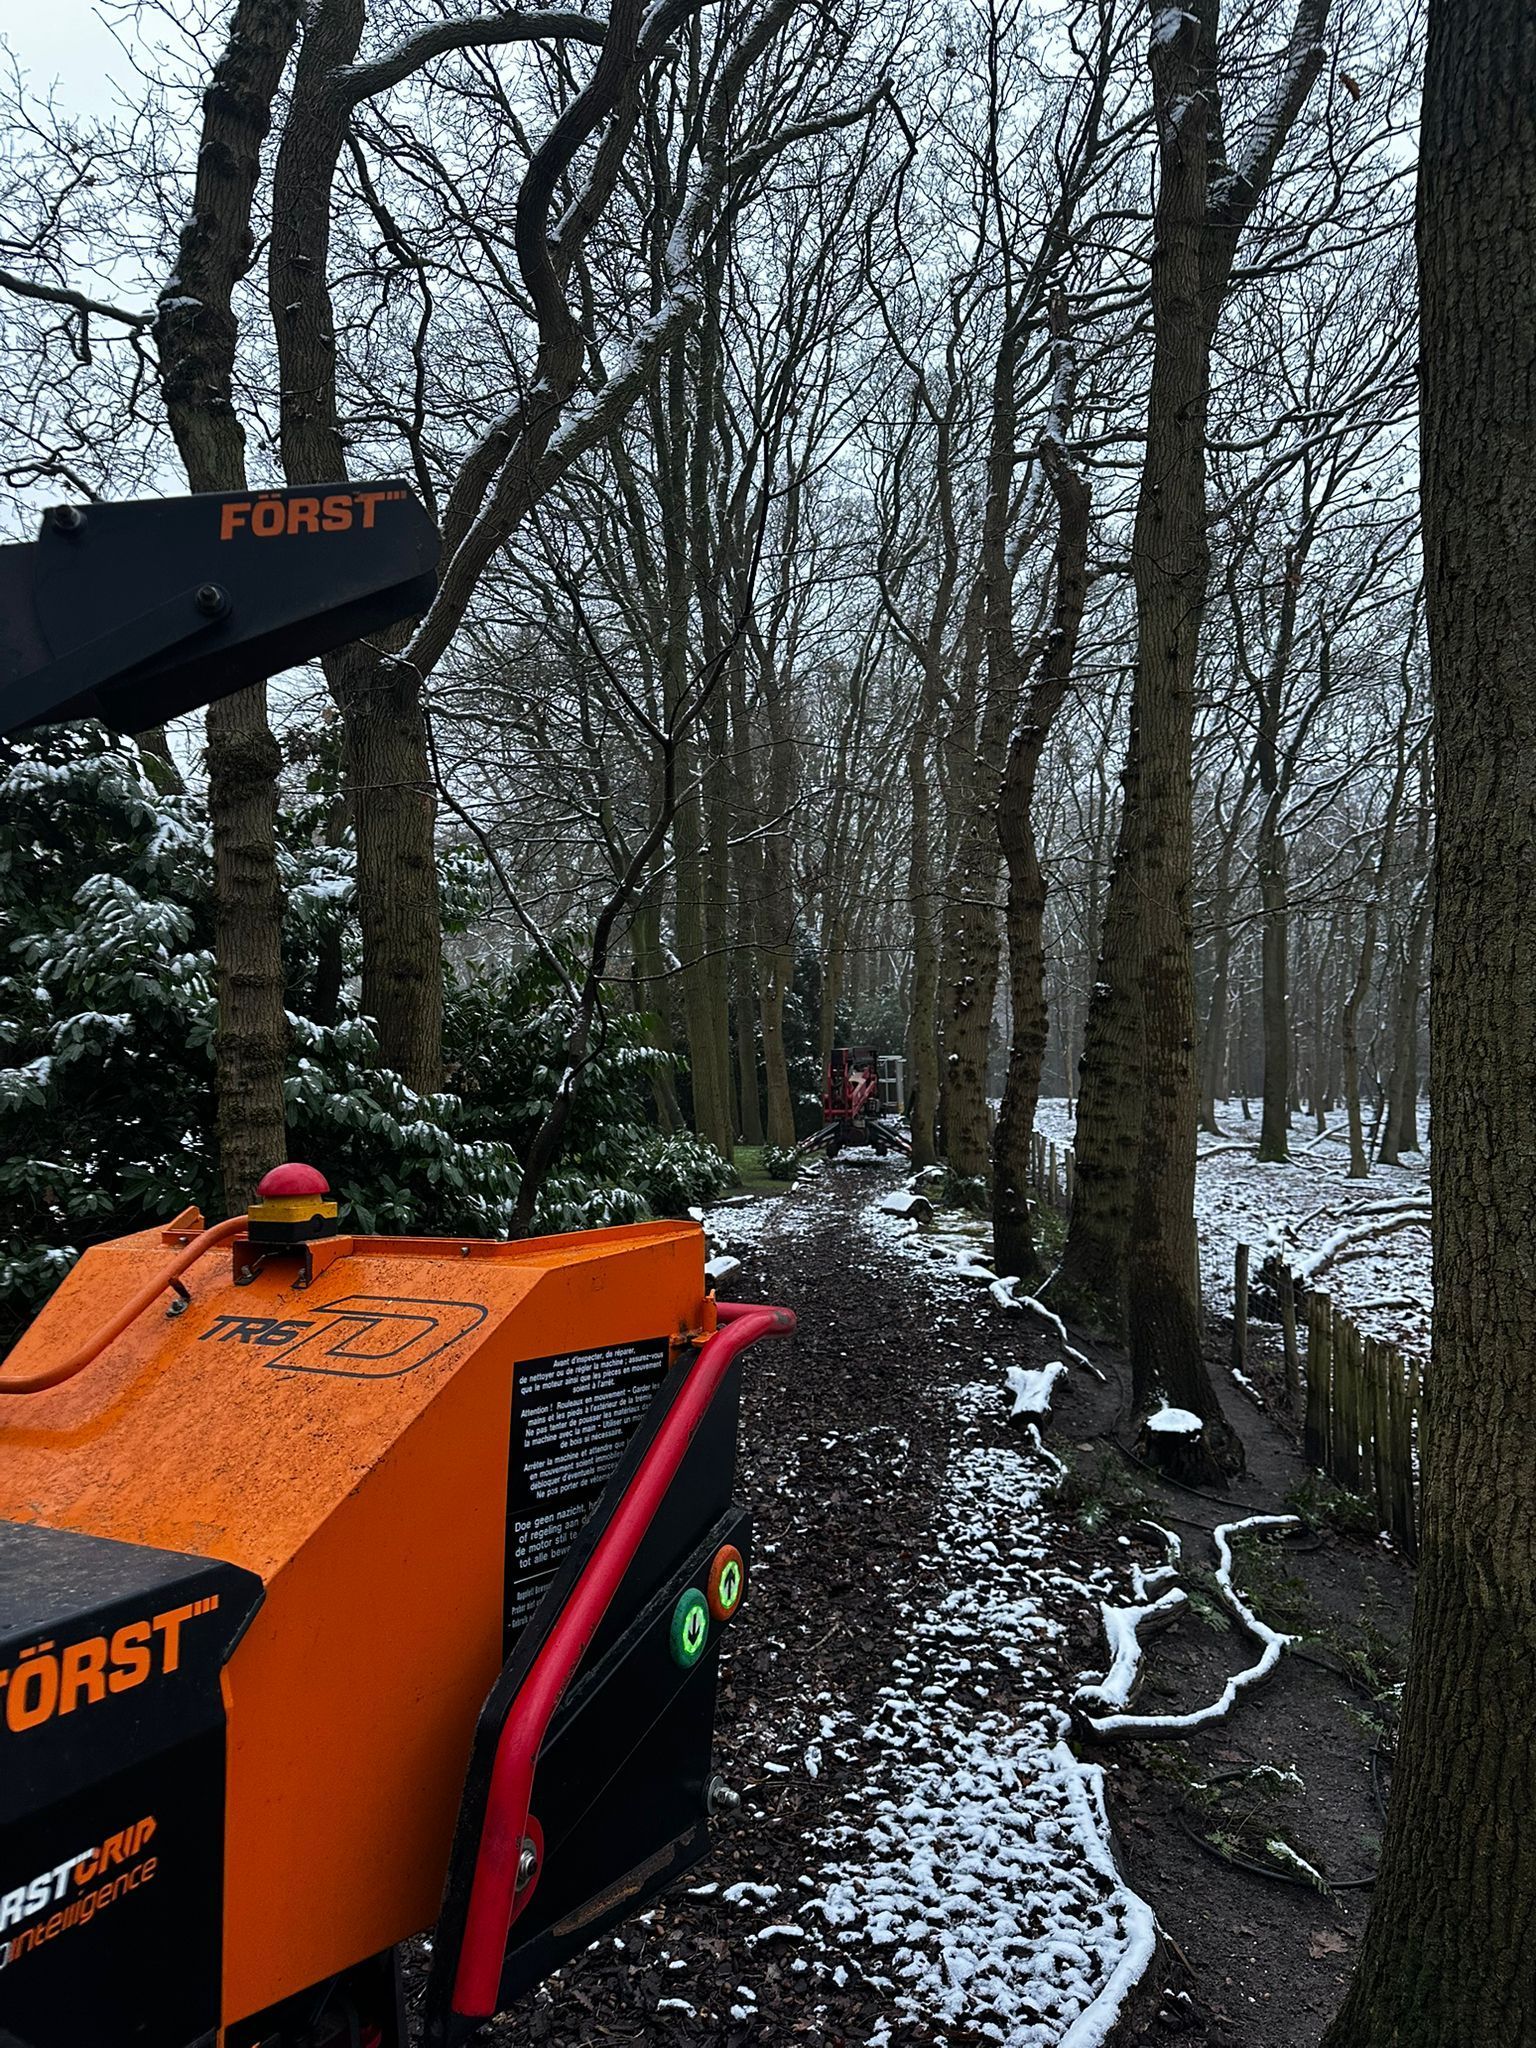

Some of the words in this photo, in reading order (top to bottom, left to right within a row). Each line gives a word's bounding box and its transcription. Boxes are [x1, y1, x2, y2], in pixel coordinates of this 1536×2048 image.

[220, 490, 407, 540] FÖRST
[198, 1315, 316, 1346] TR6
[519, 1376, 527, 1384] de
[529, 1371, 554, 1383] nettoyer
[556, 1369, 564, 1377] ou
[566, 1366, 573, 1375] de
[575, 1362, 592, 1374] régler
[594, 1360, 599, 1369] la
[601, 1358, 623, 1368] machine
[629, 1351, 663, 1363] assurez-vous
[553, 1357, 569, 1368] Avant
[571, 1352, 604, 1364] d'inspecter,
[606, 1350, 613, 1358] de
[521, 1386, 532, 1396] que
[534, 1382, 540, 1391] le
[542, 1379, 563, 1390] moteur
[565, 1377, 578, 1386] ainsi
[580, 1374, 591, 1383] que
[593, 1371, 601, 1380] les
[603, 1367, 621, 1379] pièces
[632, 1361, 662, 1372] mouvement
[572, 1382, 590, 1393] soient
[521, 1406, 549, 1418] Attention
[556, 1398, 583, 1410] Rouleaux
[594, 1389, 626, 1402] mouvement
[632, 1384, 651, 1394] Garder
[528, 1416, 546, 1426] mains
[548, 1413, 554, 1421] et
[556, 1411, 565, 1420] les
[567, 1407, 583, 1418] pieds
[619, 1397, 627, 1405] de
[628, 1396, 633, 1404] la
[524, 1439, 530, 1447] la
[532, 1433, 557, 1446] machine
[559, 1429, 573, 1439] avec
[575, 1427, 580, 1435] la
[582, 1424, 596, 1433] main
[603, 1418, 622, 1428] Utiliser
[526, 1429, 534, 1437] Ne
[536, 1425, 547, 1435] pas
[550, 1421, 567, 1431] tenter
[569, 1418, 577, 1427] de
[578, 1414, 602, 1426] pousser
[603, 1410, 612, 1419] les
[555, 1452, 579, 1463] machine
[581, 1449, 587, 1457] et
[589, 1443, 612, 1455] attendre
[614, 1441, 624, 1449] que
[560, 1440, 568, 1448] de
[570, 1436, 582, 1446] bois
[584, 1434, 589, 1443] si
[540, 1463, 574, 1477] mouvement
[576, 1458, 593, 1468] soient
[530, 1477, 560, 1490] débloquer
[536, 1490, 545, 1499] Ne
[547, 1488, 558, 1497] pas
[560, 1481, 578, 1494] porter
[580, 1478, 588, 1486] de
[515, 1521, 531, 1532] Doe
[534, 1514, 554, 1528] geen
[557, 1504, 586, 1519] nazicht,
[519, 1532, 527, 1543] of
[531, 1524, 562, 1540] regeling
[565, 1519, 579, 1529] aan
[515, 1547, 526, 1557] de
[529, 1540, 552, 1553] motor
[555, 1533, 567, 1545] stil
[570, 1531, 577, 1540] te
[520, 1557, 531, 1568] tot
[534, 1552, 548, 1563] alle
[0, 1594, 219, 1732] ÖRST
